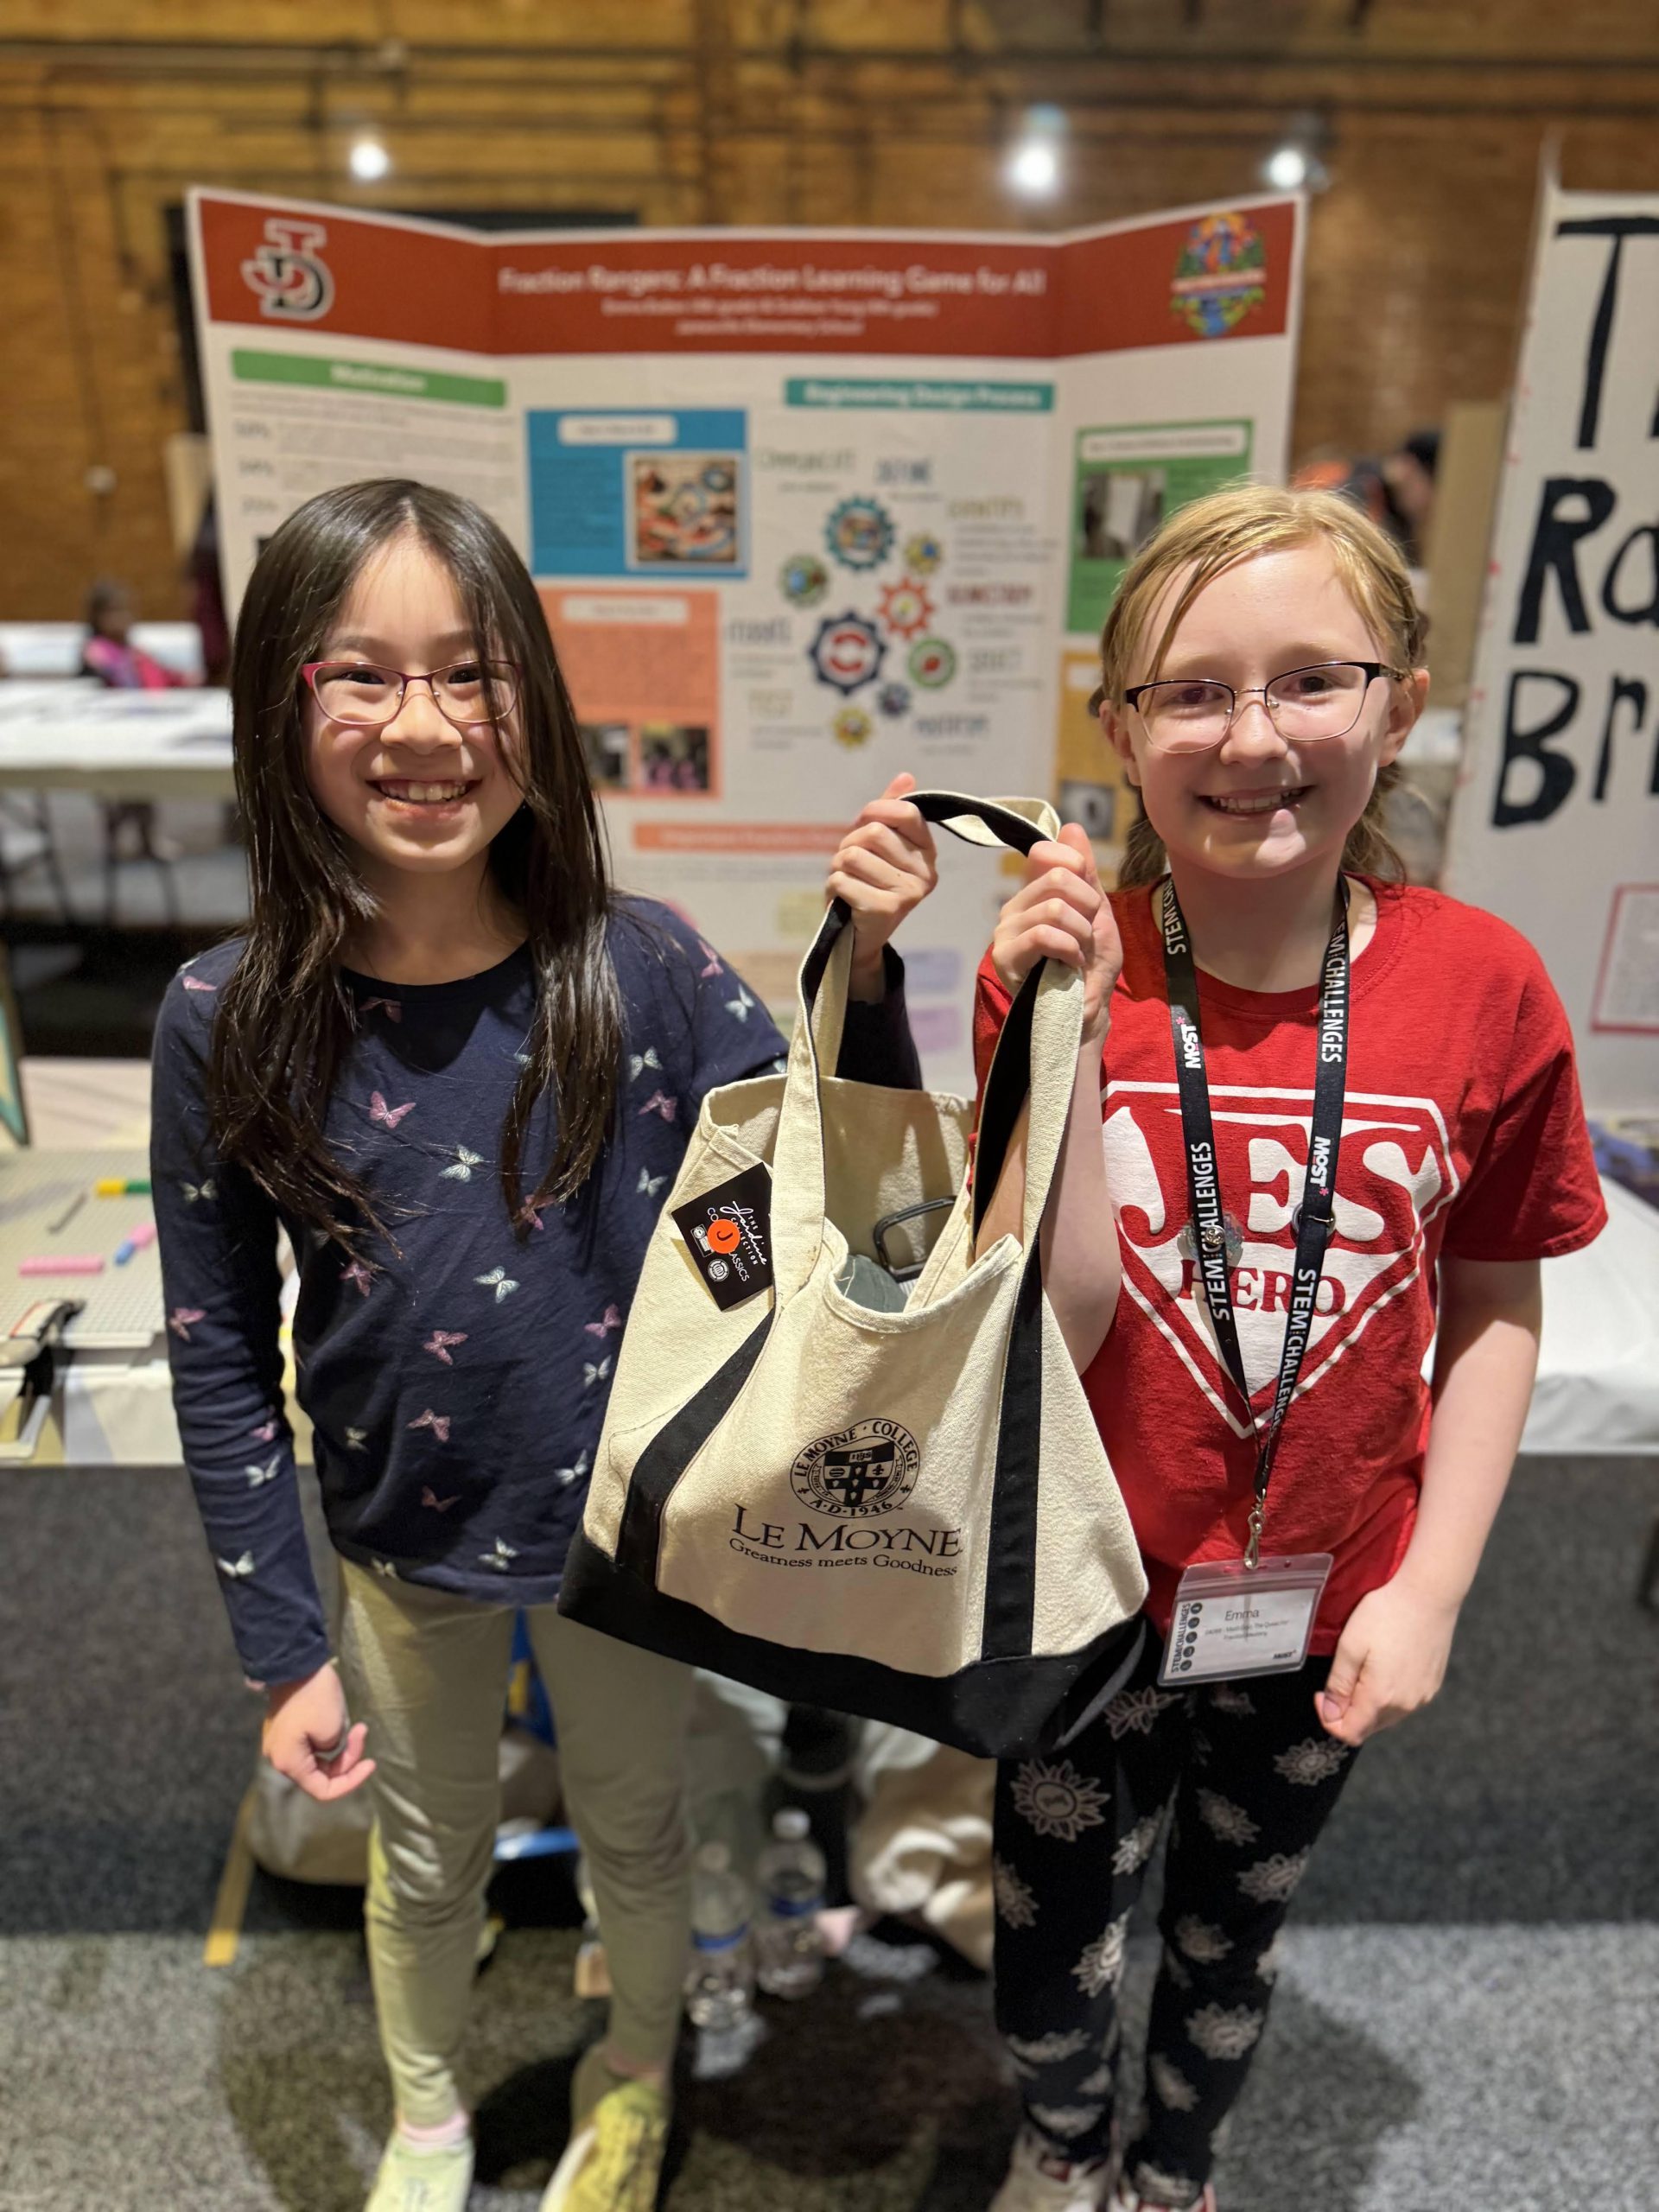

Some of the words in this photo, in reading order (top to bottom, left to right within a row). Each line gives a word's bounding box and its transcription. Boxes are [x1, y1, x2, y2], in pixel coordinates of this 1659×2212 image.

[1120, 1107, 1427, 1256] JES
[794, 1462, 810, 1477] LE
[803, 1427, 858, 1463] MOYNE
[872, 1421, 918, 1471] COLLEGE
[733, 1504, 785, 1548] LE
[795, 1522, 963, 1557] MOYNE
[728, 1538, 812, 1567] Greatness
[817, 1555, 868, 1567] meets
[873, 1554, 957, 1577] Goodness
[1224, 1610, 1260, 1621] Emma
